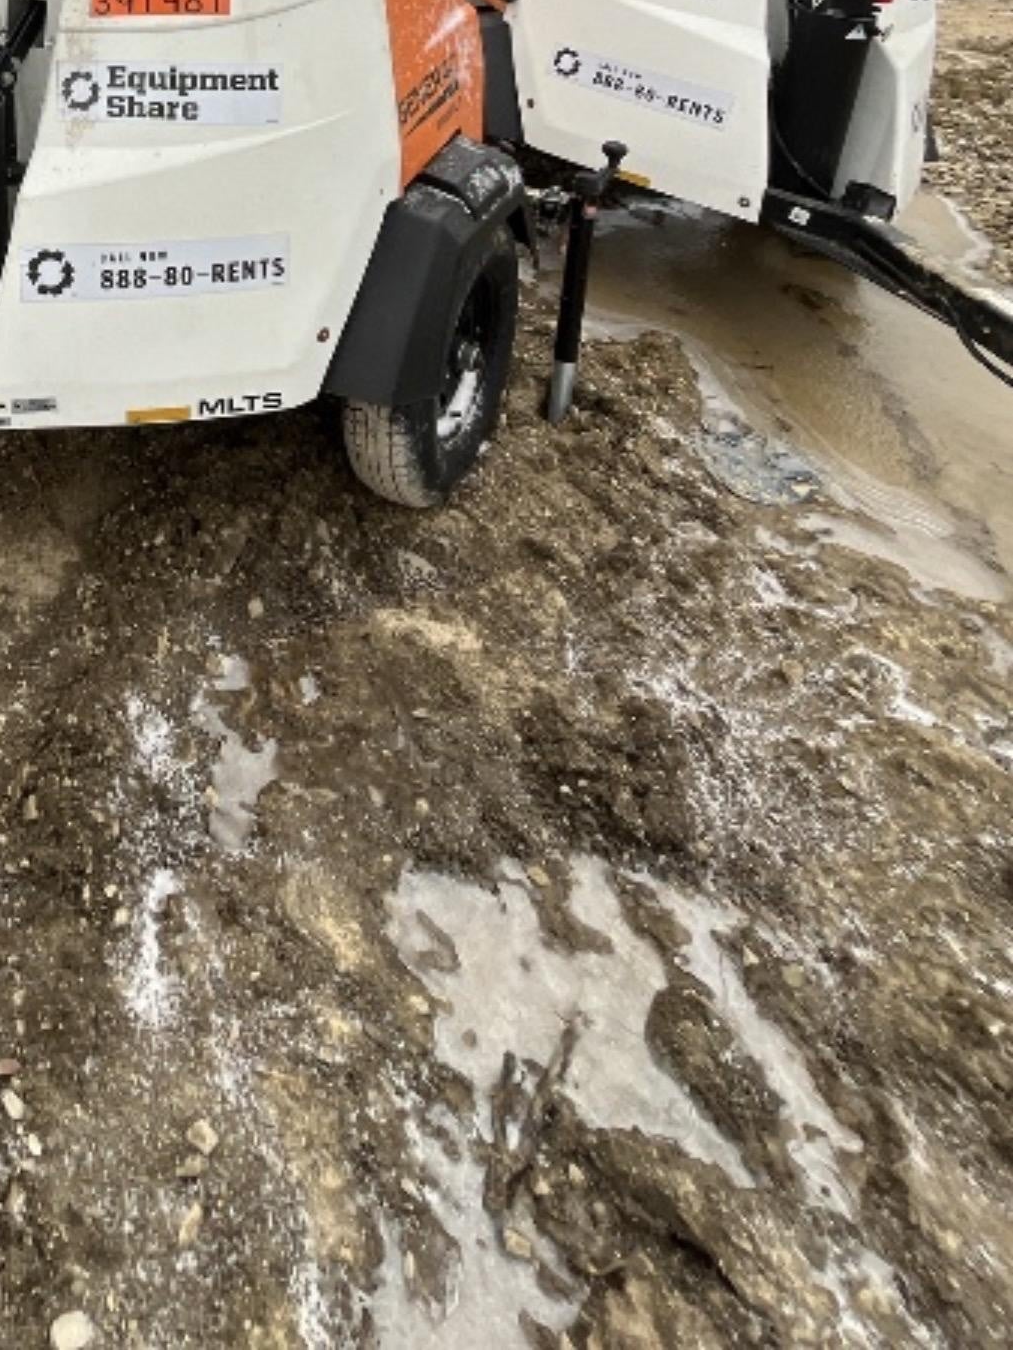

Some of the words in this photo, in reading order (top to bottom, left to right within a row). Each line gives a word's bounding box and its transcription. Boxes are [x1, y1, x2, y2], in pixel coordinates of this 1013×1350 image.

[106, 65, 279, 96] Equipment
[106, 95, 199, 120] Share
[100, 257, 285, 289] 888-80-RENTS
[198, 392, 282, 416] MLTS
